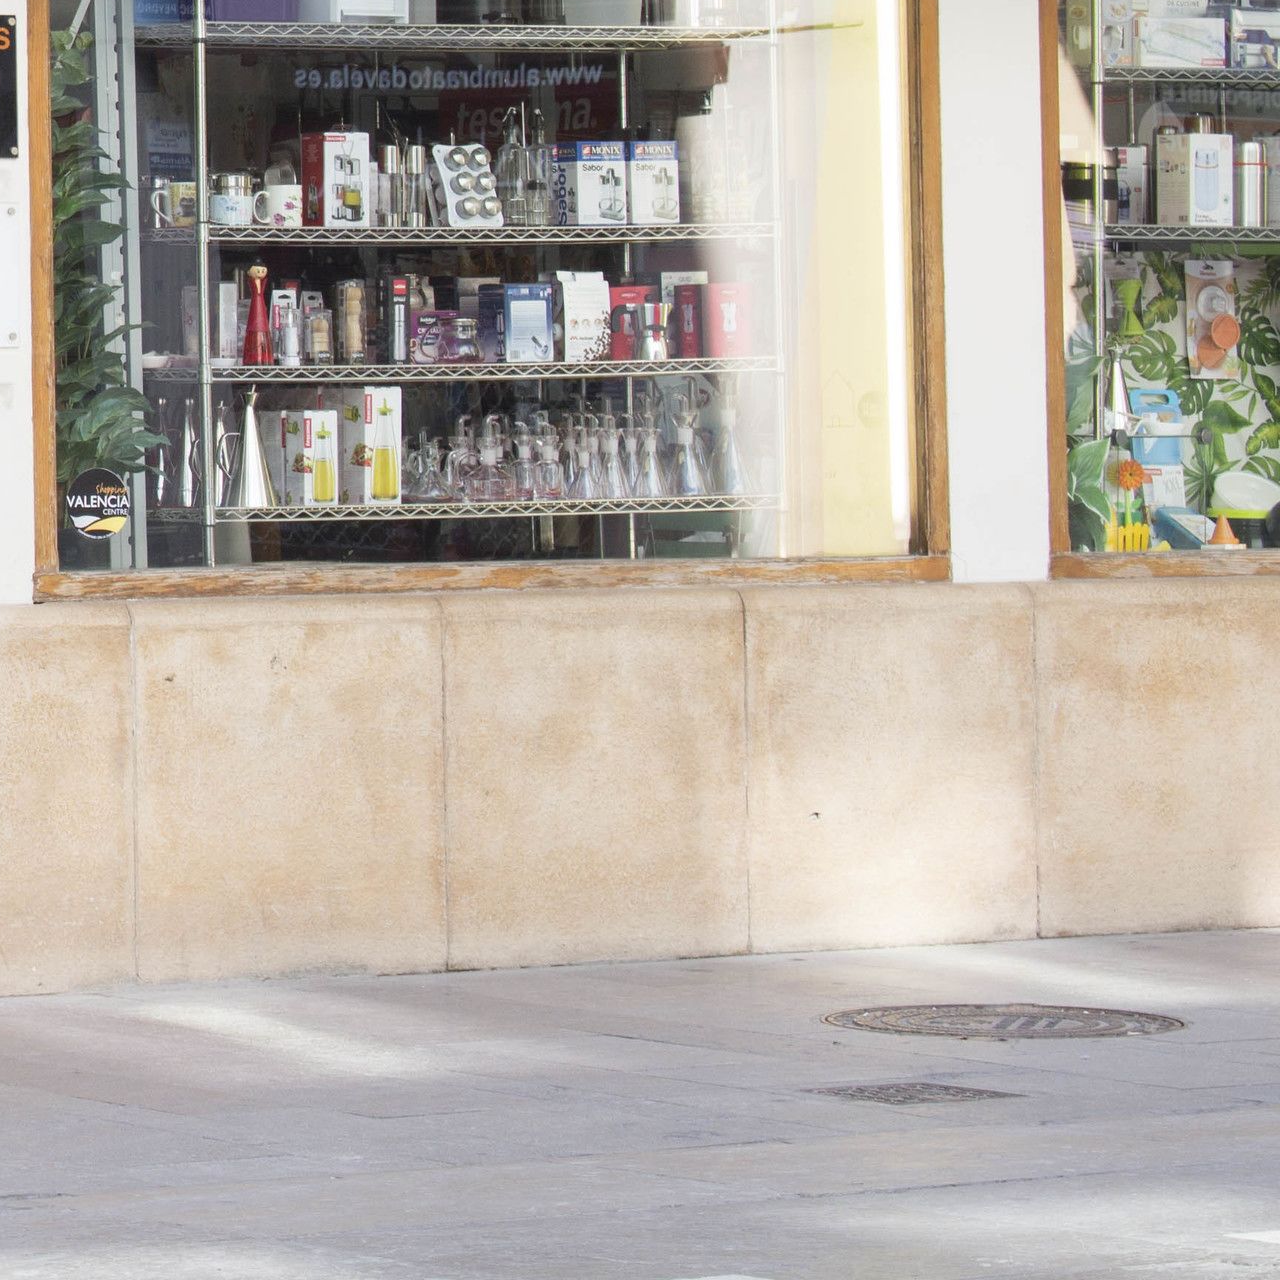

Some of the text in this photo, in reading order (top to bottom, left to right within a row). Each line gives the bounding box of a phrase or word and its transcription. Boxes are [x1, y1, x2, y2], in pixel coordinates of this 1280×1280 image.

[591, 146, 620, 155] MONIX
[644, 146, 672, 155] MONIX
[582, 164, 604, 172] Sabor
[635, 163, 656, 171] Sabor
[66, 495, 130, 508] VALENCIA
[102, 508, 128, 516] CENTRE
